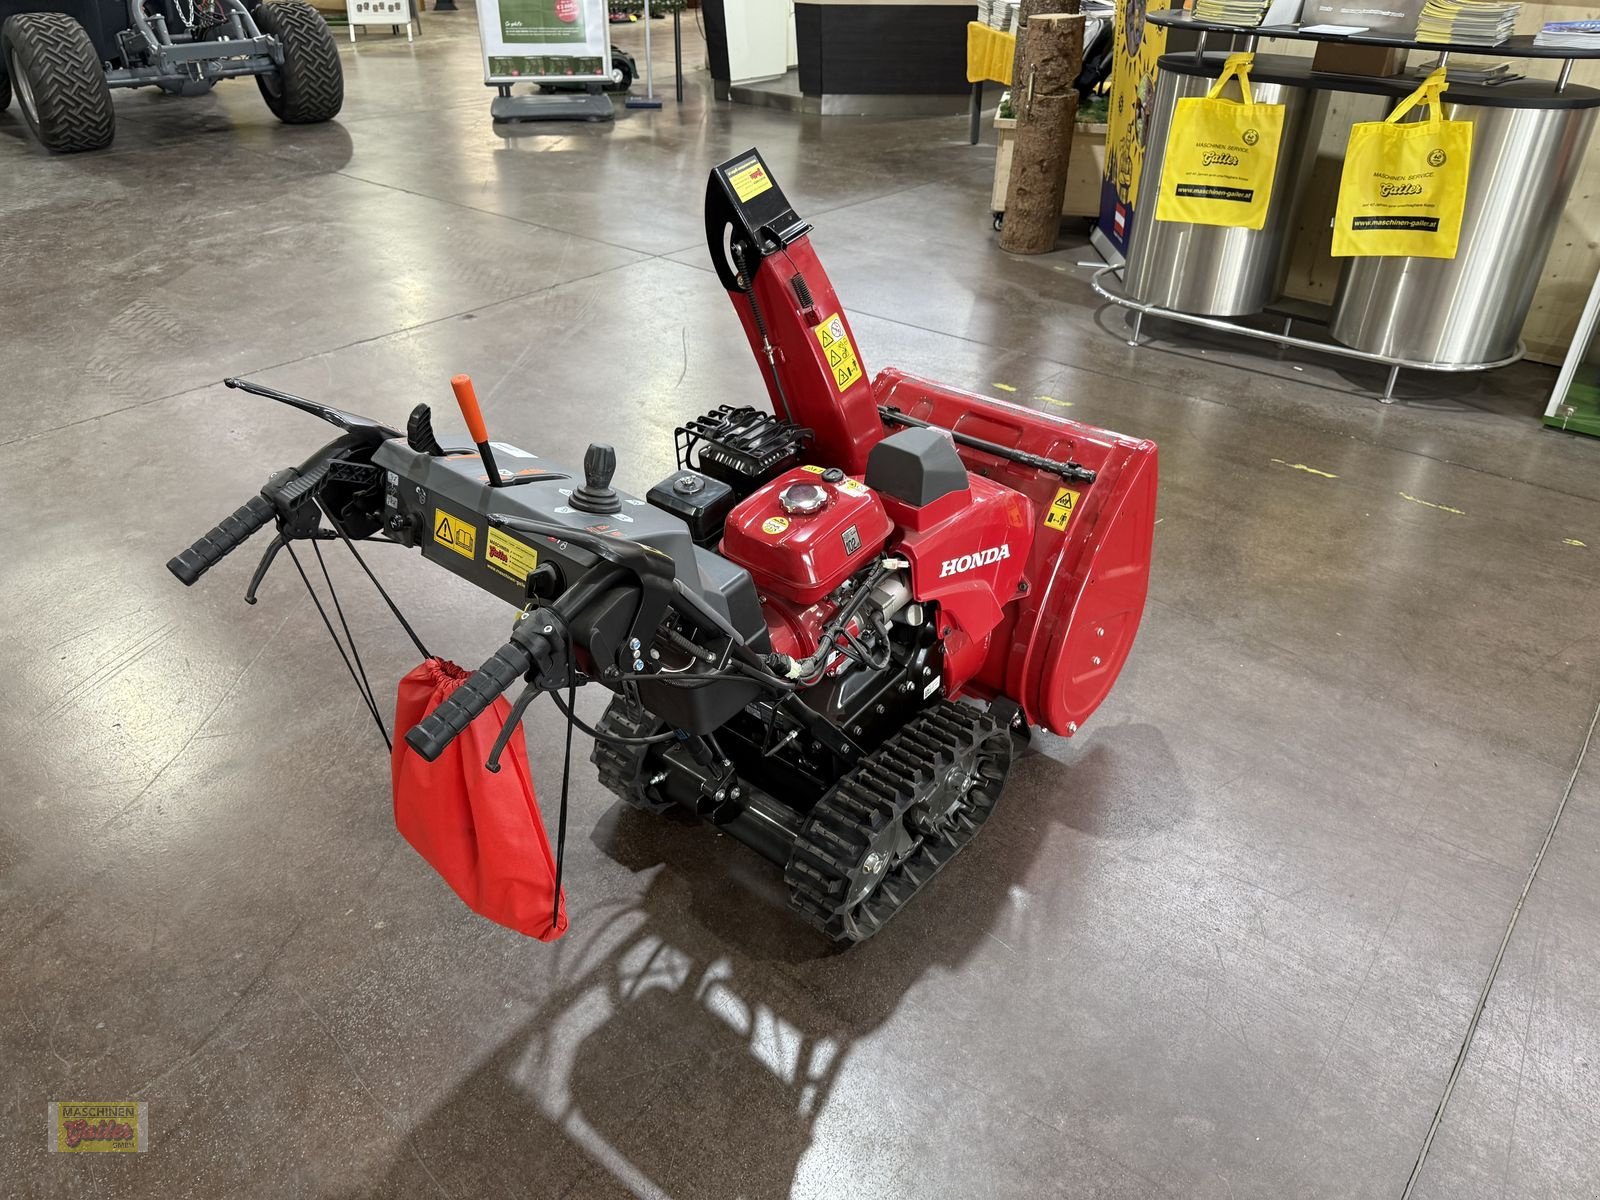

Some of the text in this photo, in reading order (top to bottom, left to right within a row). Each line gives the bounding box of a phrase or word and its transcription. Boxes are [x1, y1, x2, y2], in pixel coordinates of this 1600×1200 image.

[1202, 151, 1239, 167] Gailer
[1177, 187, 1251, 199] www.maschinen-gailer.at
[1380, 182, 1422, 198] Gailer
[1354, 219, 1437, 228] www.maschinen-gailer.at
[939, 544, 1011, 578] HONDA
